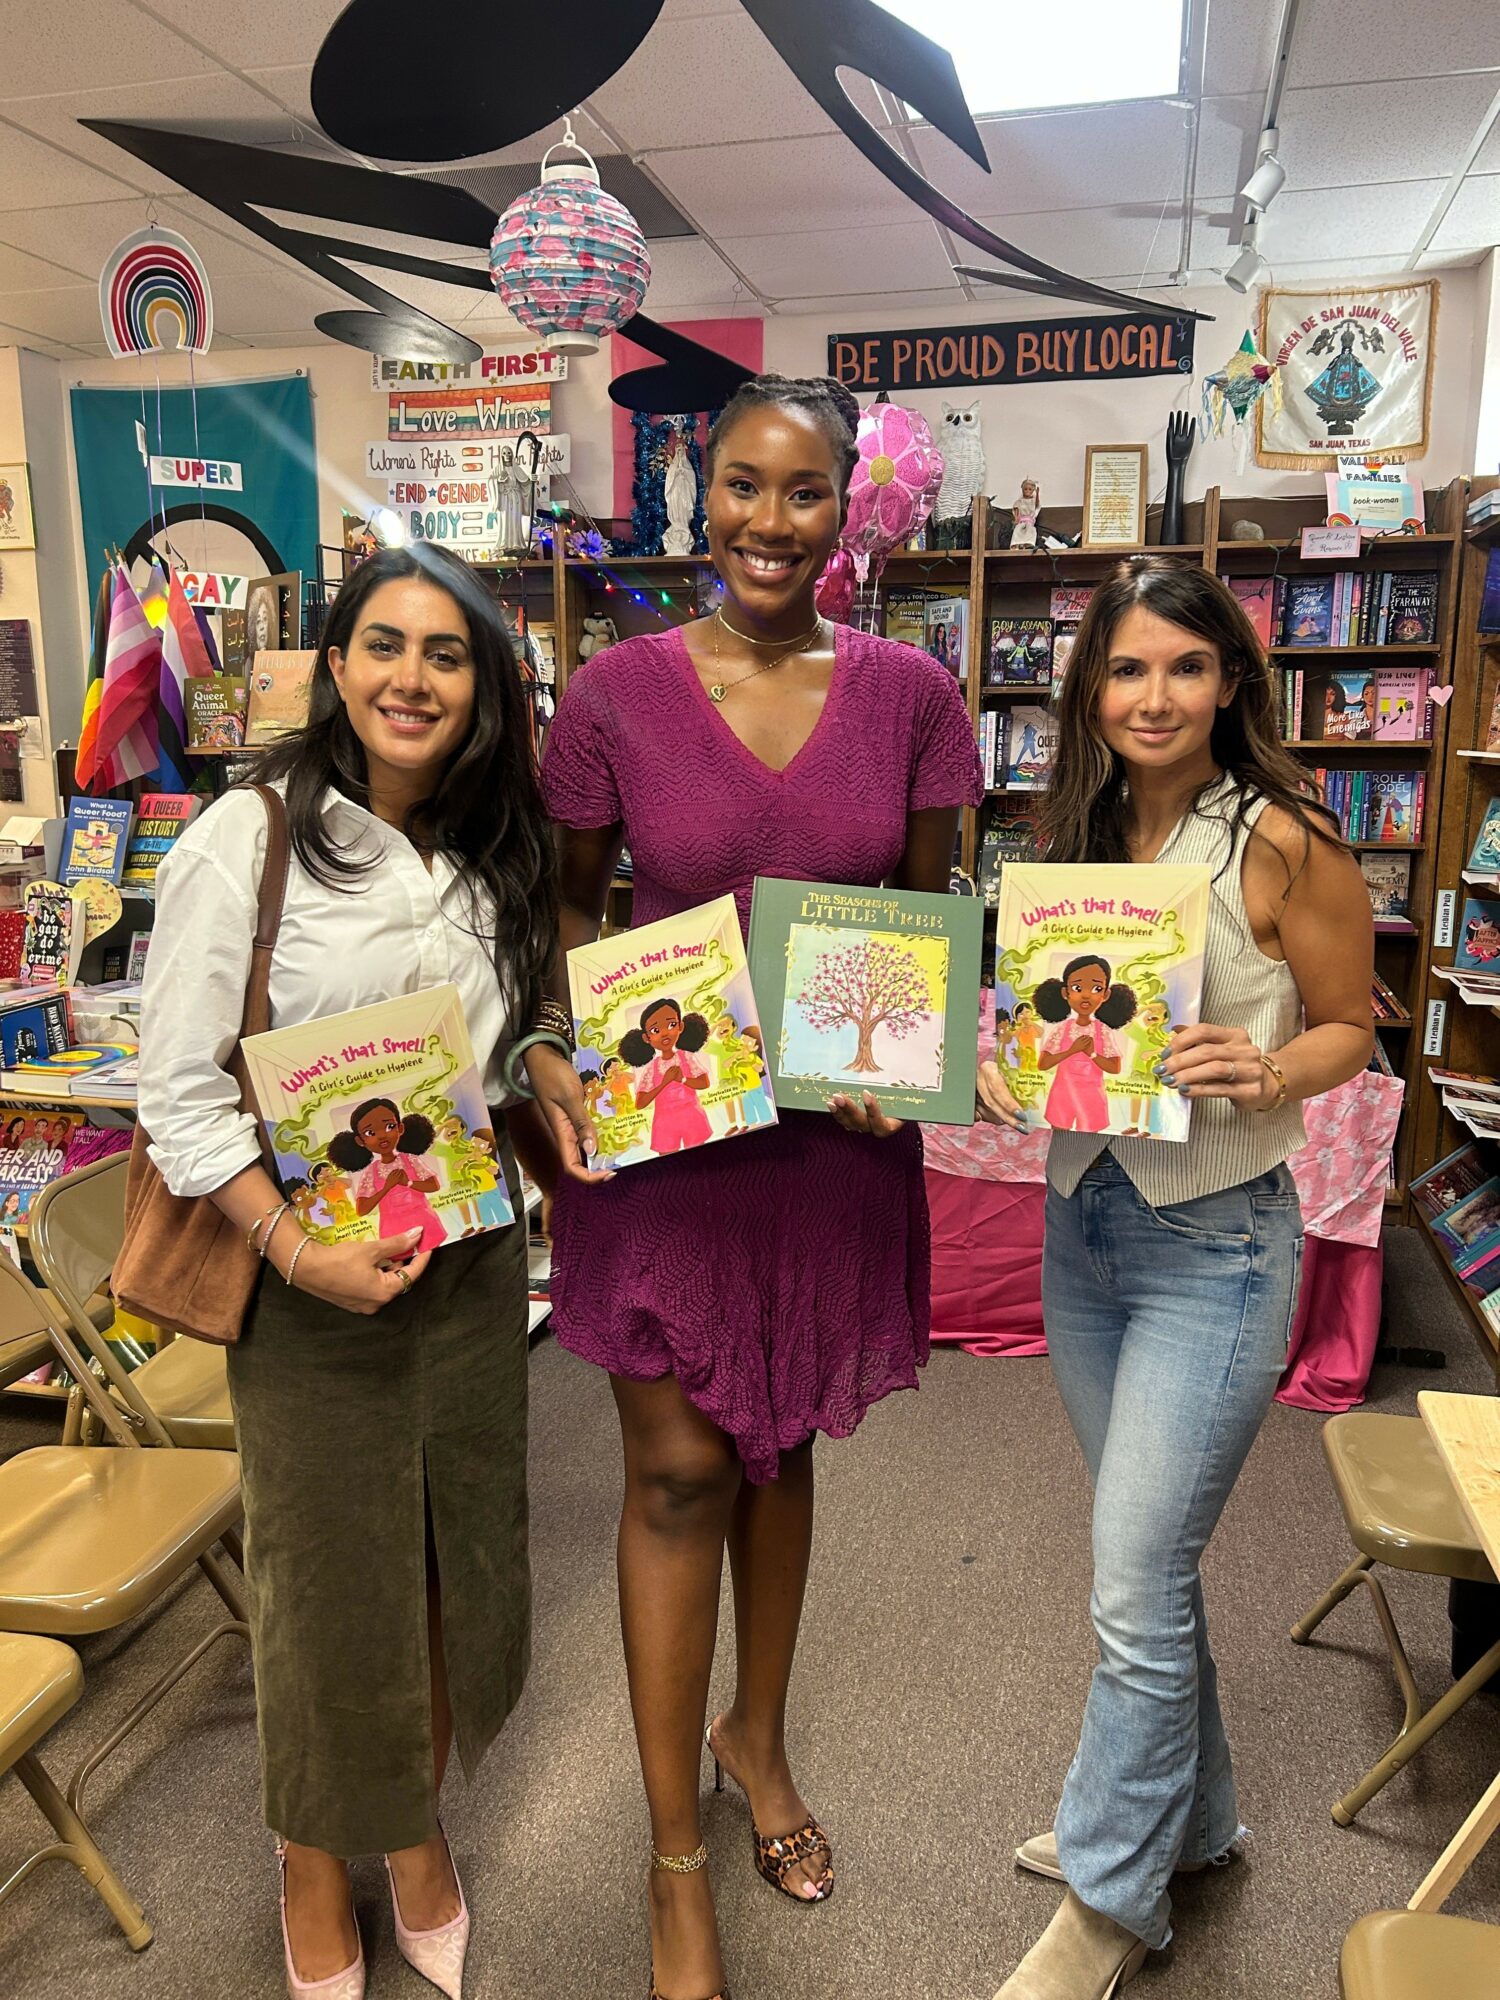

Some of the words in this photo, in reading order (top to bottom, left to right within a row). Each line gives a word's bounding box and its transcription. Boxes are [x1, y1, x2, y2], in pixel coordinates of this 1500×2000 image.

[1276, 330, 1303, 366] VIRGEN
[1301, 315, 1318, 333] DE
[1320, 305, 1344, 322] SAN
[1349, 305, 1381, 319] JUAN
[1380, 312, 1402, 333] DEL
[1398, 327, 1418, 363] VALLE
[836, 339, 881, 384] BE
[892, 335, 1006, 384] PROUD
[1016, 329, 1079, 376] BUY
[1084, 324, 1178, 373] LOCAL
[381, 360, 471, 381] EARTH
[481, 351, 557, 378] FIRST
[398, 401, 458, 433] Love
[474, 396, 541, 431] Wins
[1309, 439, 1324, 448] SAN
[1348, 438, 1371, 448] TEXAS
[369, 448, 417, 471] Women's
[421, 446, 457, 478] Rights
[1382, 455, 1405, 466] ALL
[160, 459, 234, 485] SUPER
[1346, 473, 1402, 483] FAMILIES
[395, 482, 427, 504] END
[437, 482, 489, 505] GENDE
[1353, 496, 1399, 505] book-woman
[410, 510, 461, 540] BODY
[182, 573, 242, 605] GAY
[1408, 588, 1420, 596] THE
[1296, 593, 1323, 604] April
[1395, 596, 1431, 607] FARAWAY
[931, 607, 942, 615] SAFE
[1292, 604, 1322, 615] Evans
[1404, 608, 1419, 617] INN
[193, 691, 224, 701] Queer
[192, 701, 228, 710] Animal
[1327, 712, 1346, 722] More
[1348, 711, 1365, 721] Like
[1327, 719, 1371, 735] Enemigas
[1372, 774, 1406, 784] ROLE
[74, 807, 100, 816] Queer
[101, 810, 127, 818] Food?
[144, 801, 150, 815] A
[153, 801, 183, 815] QUEER
[138, 820, 179, 836] HISTORY
[65, 865, 84, 873] John
[86, 866, 116, 875] Birdsall
[808, 892, 831, 904] THE
[833, 894, 882, 908] SEASONS
[883, 900, 899, 911] OF
[1443, 894, 1452, 907] Pulp
[43, 911, 56, 923] be
[800, 900, 877, 923] LITTLE
[883, 908, 944, 929] TREE
[1021, 898, 1077, 928] What's
[1081, 897, 1115, 915] that
[1120, 899, 1177, 932] Smell?
[1441, 909, 1450, 930] Lesbian
[38, 925, 59, 938] gay
[1041, 924, 1048, 933] A
[1051, 923, 1074, 934] Girl's
[1076, 924, 1103, 935] Guide
[1105, 926, 1115, 935] to
[1117, 926, 1153, 938] Hygiene
[1440, 932, 1448, 943] New
[40, 937, 53, 948] do
[28, 953, 62, 965] crime
[590, 961, 638, 995] What's
[639, 949, 669, 968] that
[672, 938, 719, 959] Smell?
[611, 987, 618, 996] A
[619, 980, 639, 994] Girl's
[641, 973, 664, 987] Guide
[665, 969, 673, 979] to
[674, 959, 705, 977] Hygiene
[47, 1006, 58, 1025] BIRD
[1433, 1003, 1443, 1017] Pulp
[1430, 1018, 1440, 1039] Lesbian
[1429, 1041, 1437, 1052] New
[280, 1054, 339, 1094] What's
[341, 1041, 378, 1064] that
[382, 1034, 441, 1056] Smell?
[309, 1084, 318, 1094] A
[319, 1076, 344, 1092] Girl's
[346, 1070, 374, 1084] Guide
[375, 1066, 386, 1075] to
[387, 1057, 424, 1073] Hygiene
[26, 1149, 63, 1167] AND
[0, 1163, 53, 1183] ARLESS
[336, 1221, 360, 1234] Written
